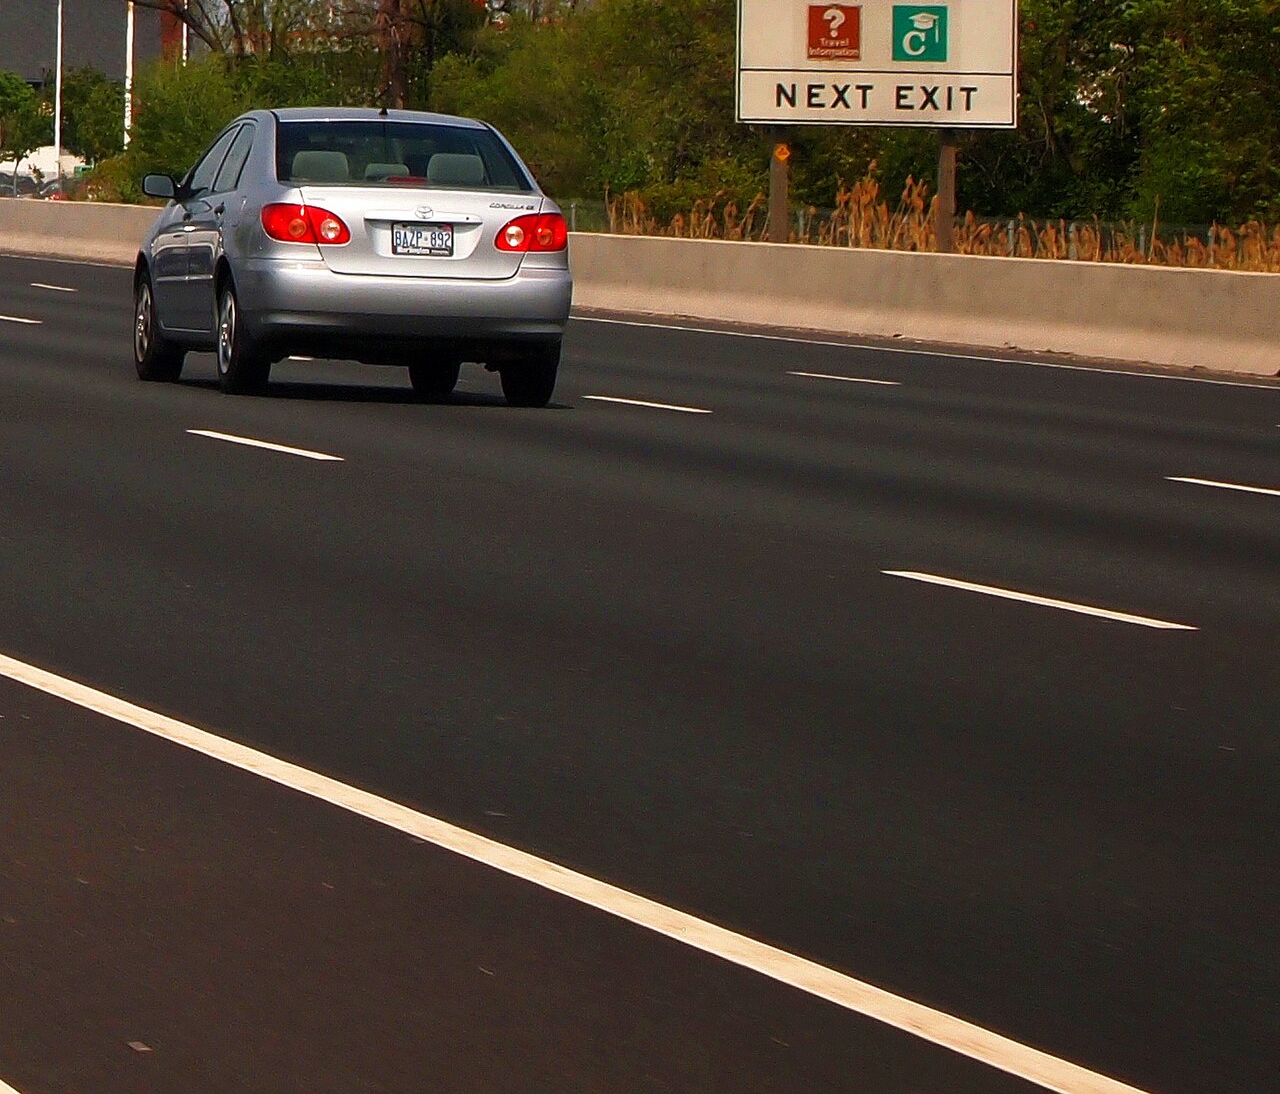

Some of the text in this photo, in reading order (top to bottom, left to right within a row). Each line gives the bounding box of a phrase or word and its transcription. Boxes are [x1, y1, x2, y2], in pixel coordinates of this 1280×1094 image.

[819, 37, 850, 47] Travel
[902, 31, 926, 56] C
[808, 47, 860, 57] Information
[776, 83, 979, 112] NEXT EXIT
